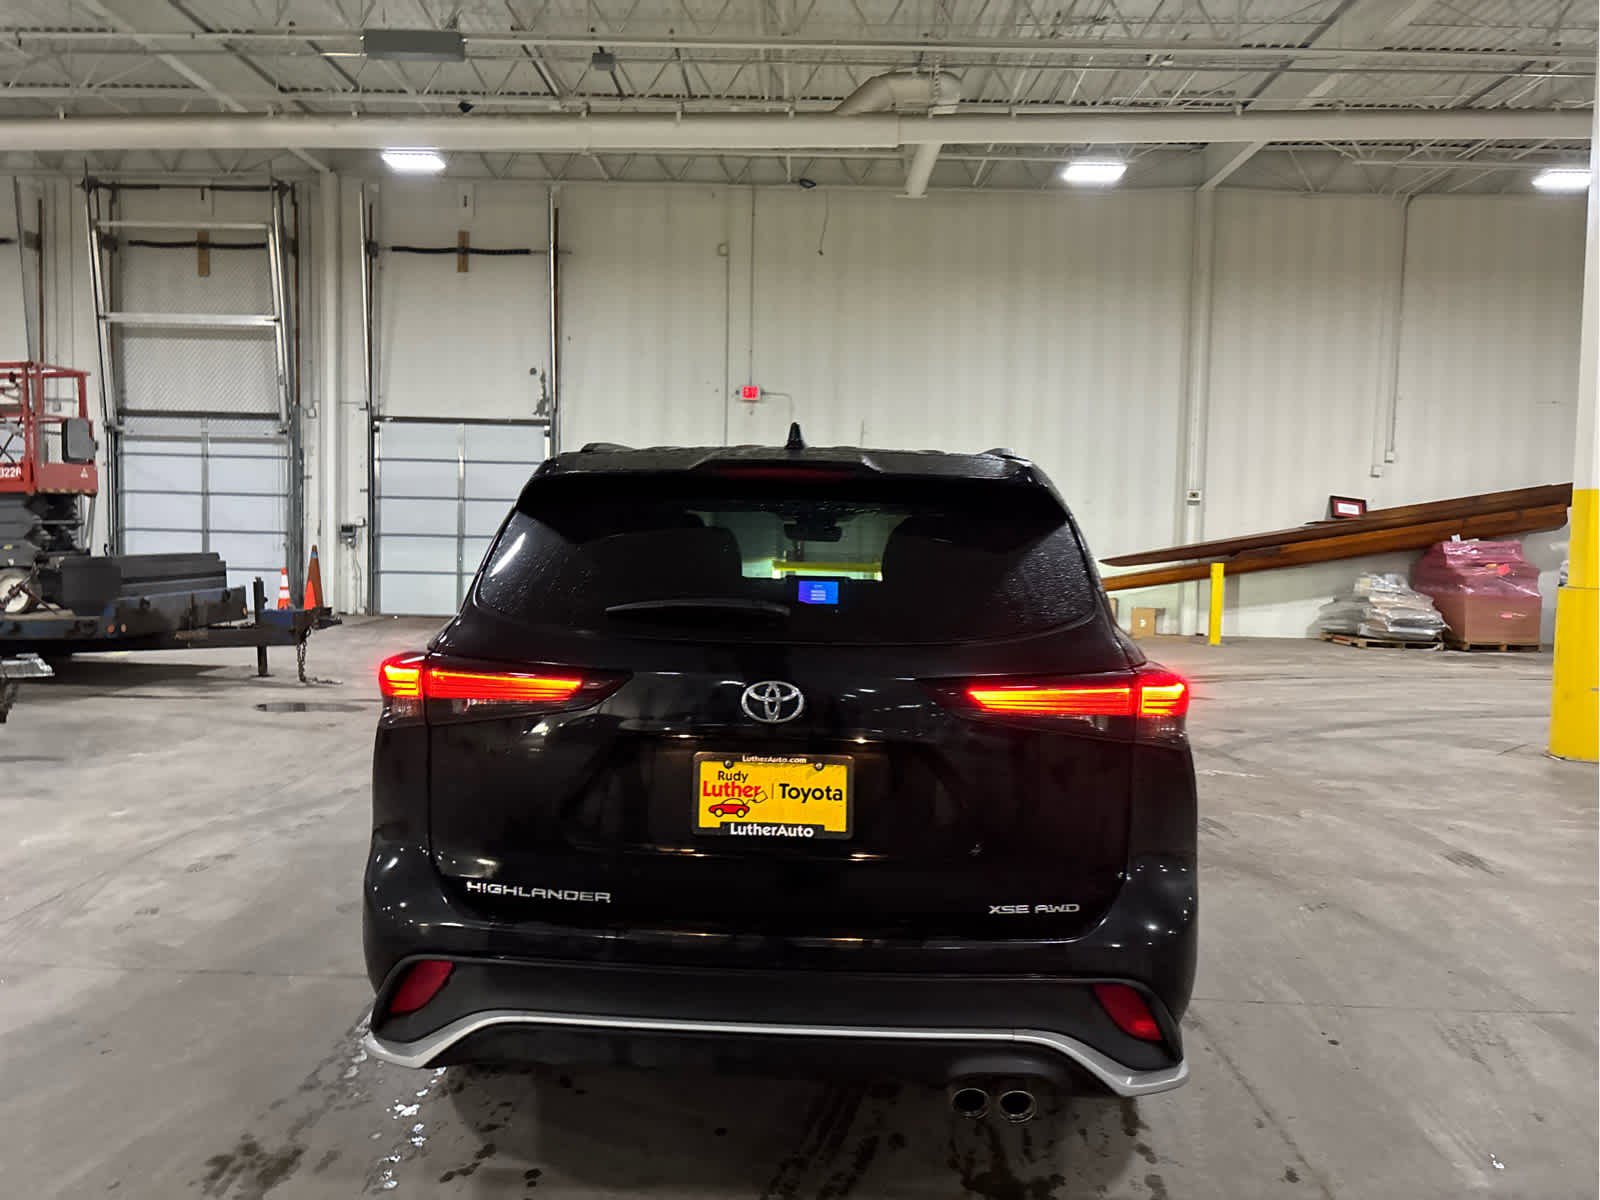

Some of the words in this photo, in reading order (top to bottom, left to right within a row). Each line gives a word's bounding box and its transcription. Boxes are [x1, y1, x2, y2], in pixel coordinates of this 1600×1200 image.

[742, 754, 807, 764] LutherAuto.com
[717, 770, 749, 783] Rudy
[703, 781, 762, 798] Luther
[778, 783, 843, 803] Toyota
[729, 822, 815, 838] LutherAuto
[466, 880, 611, 903] HIGHLANDER
[988, 904, 1031, 914] XSE
[1034, 903, 1080, 914] AWD
